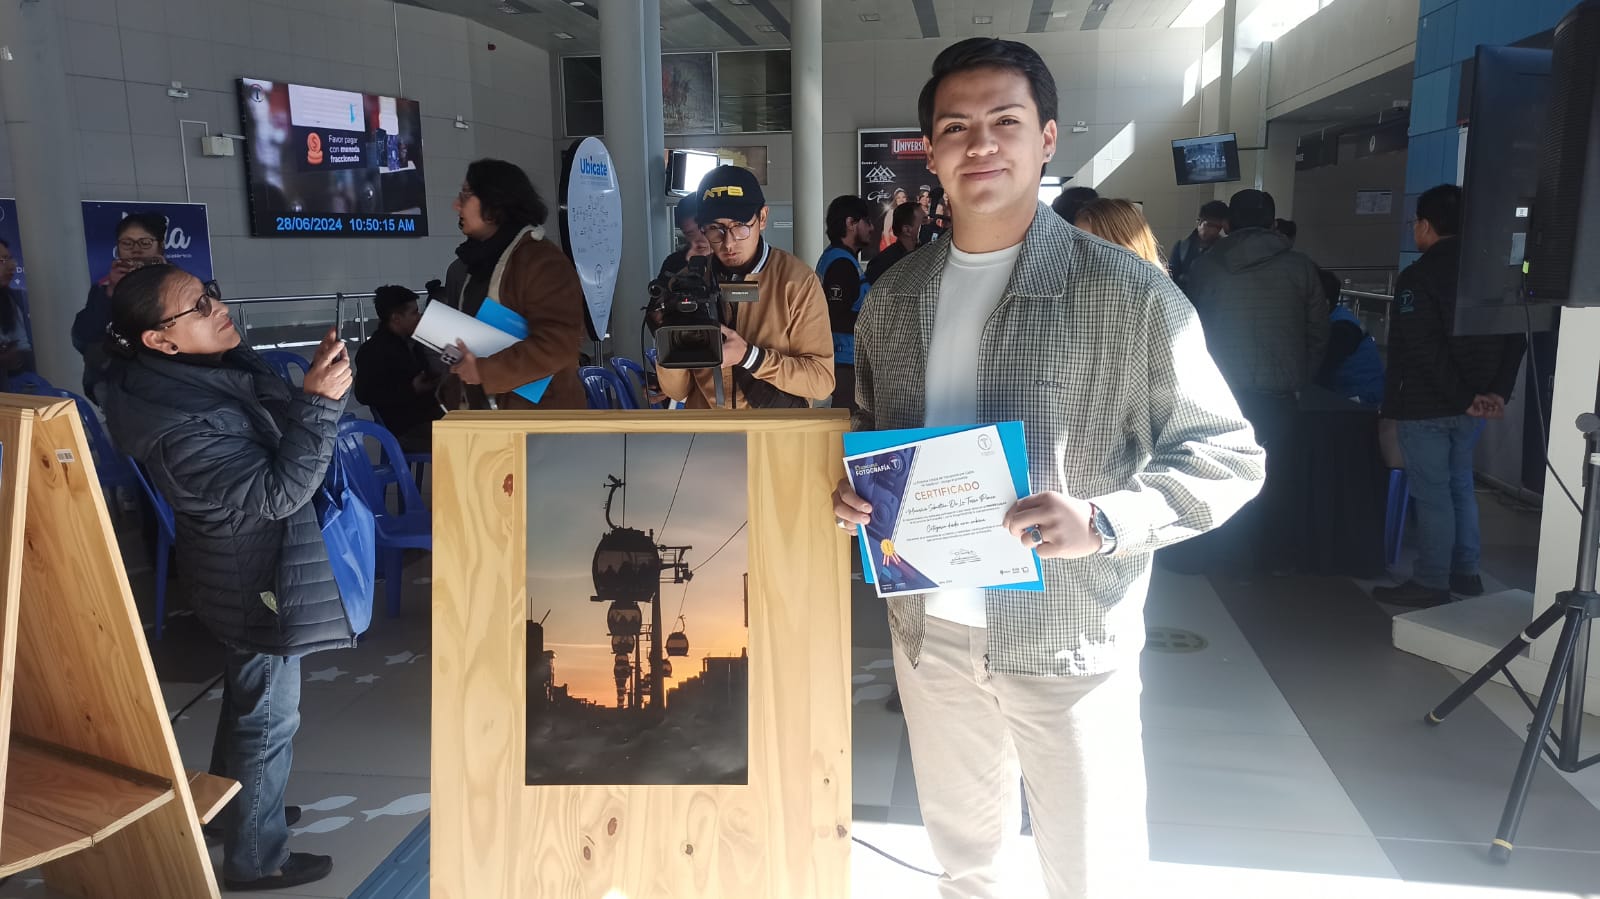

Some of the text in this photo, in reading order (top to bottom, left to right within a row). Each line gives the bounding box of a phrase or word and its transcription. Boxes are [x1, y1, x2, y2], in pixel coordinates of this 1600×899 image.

[328, 134, 358, 145] Favor pagar
[330, 155, 360, 163] fraccionada
[580, 155, 608, 176] Ubicate
[276, 217, 415, 232] 28/06/2024 10:50:15 AM
[914, 480, 980, 501] CERTIFICADO
